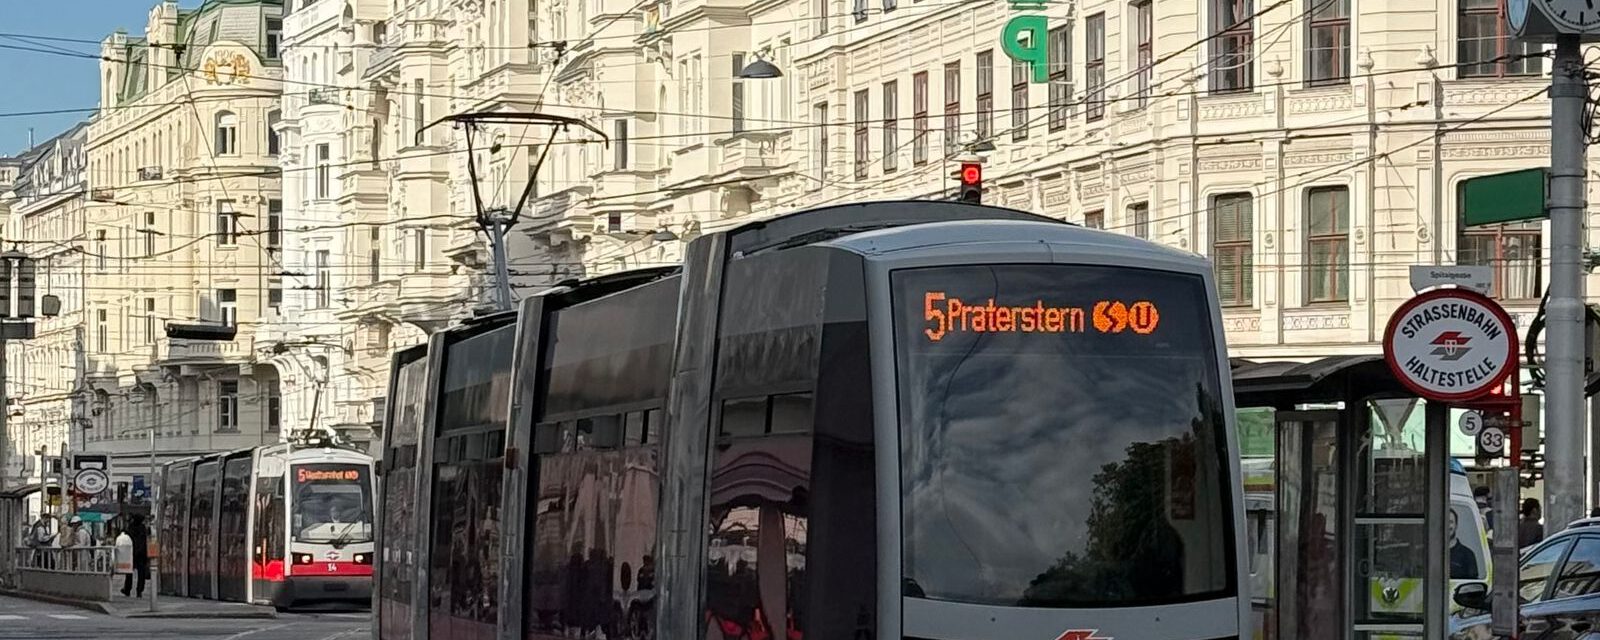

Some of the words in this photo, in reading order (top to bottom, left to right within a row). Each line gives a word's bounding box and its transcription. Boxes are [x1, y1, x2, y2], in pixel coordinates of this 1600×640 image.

[924, 291, 945, 341] 5
[948, 298, 1085, 333] Praterstern
[1401, 303, 1501, 340] STRASSENBAHN
[1405, 356, 1497, 388] HALTESTELLE
[1465, 416, 1476, 431] 5
[1482, 431, 1503, 448] 33
[297, 468, 306, 482] 5
